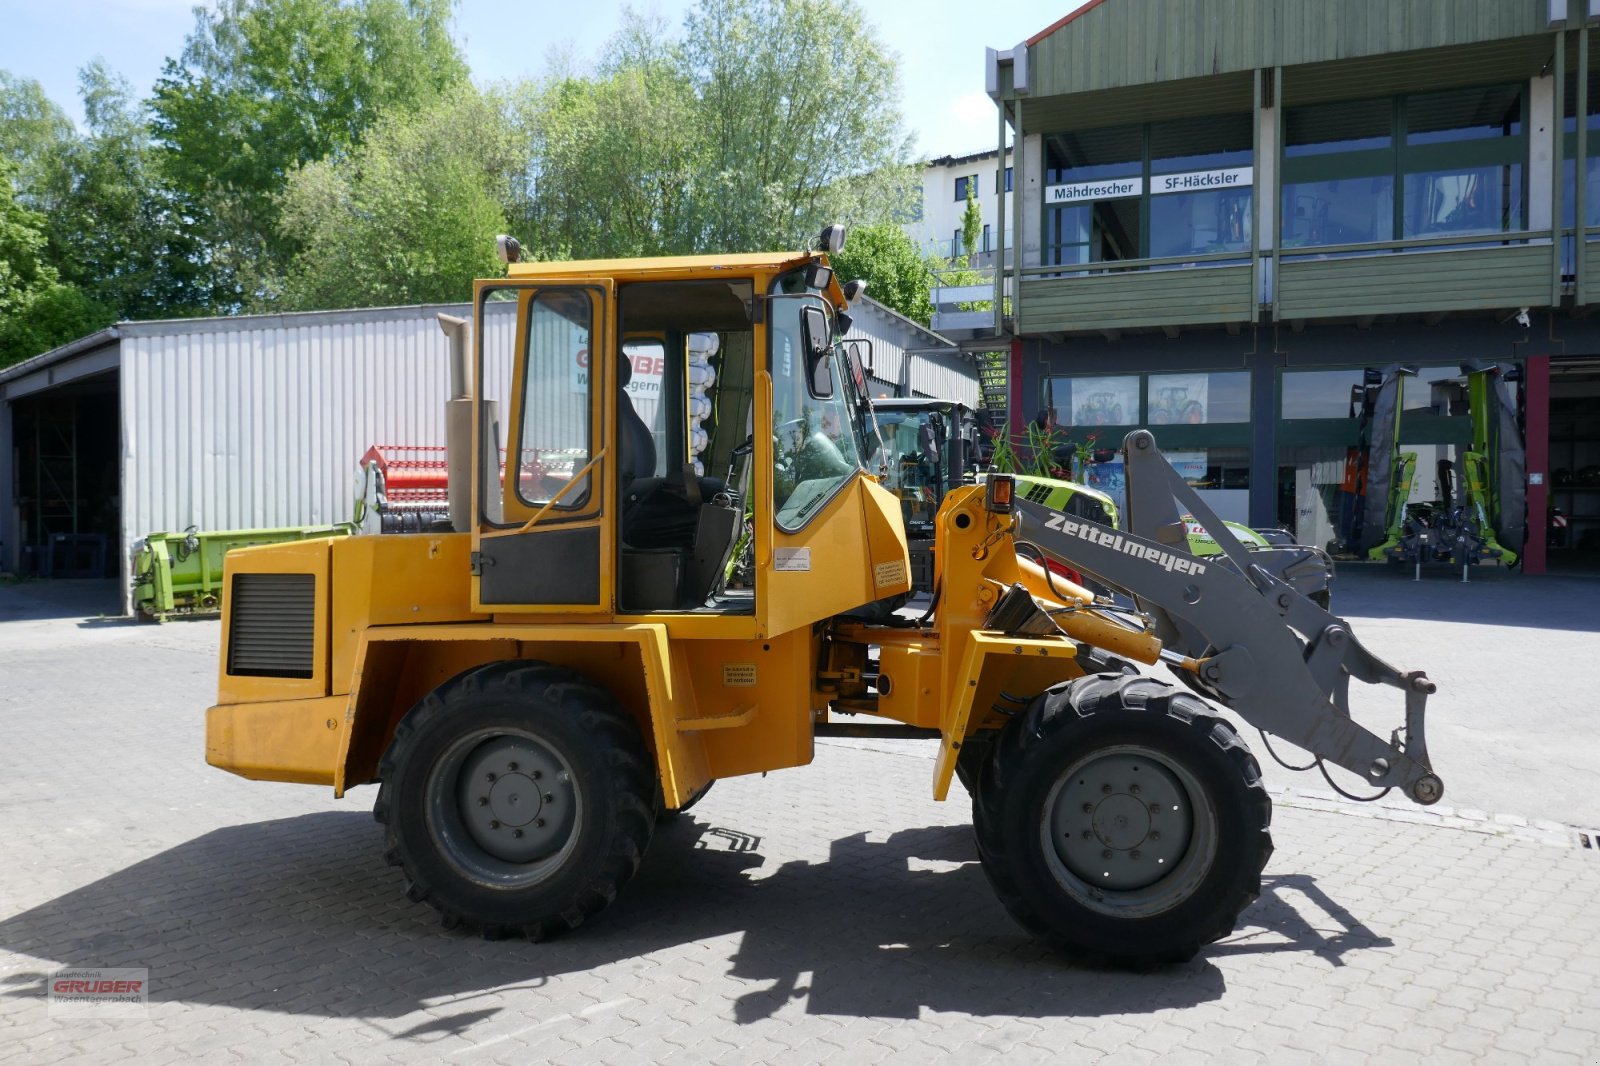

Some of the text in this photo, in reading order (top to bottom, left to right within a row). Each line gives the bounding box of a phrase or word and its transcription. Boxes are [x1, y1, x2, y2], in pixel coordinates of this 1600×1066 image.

[1164, 172, 1239, 189] SF-Häcksler
[1054, 183, 1134, 199] Mähdrescher
[1044, 512, 1206, 576] Zettelmeyer
